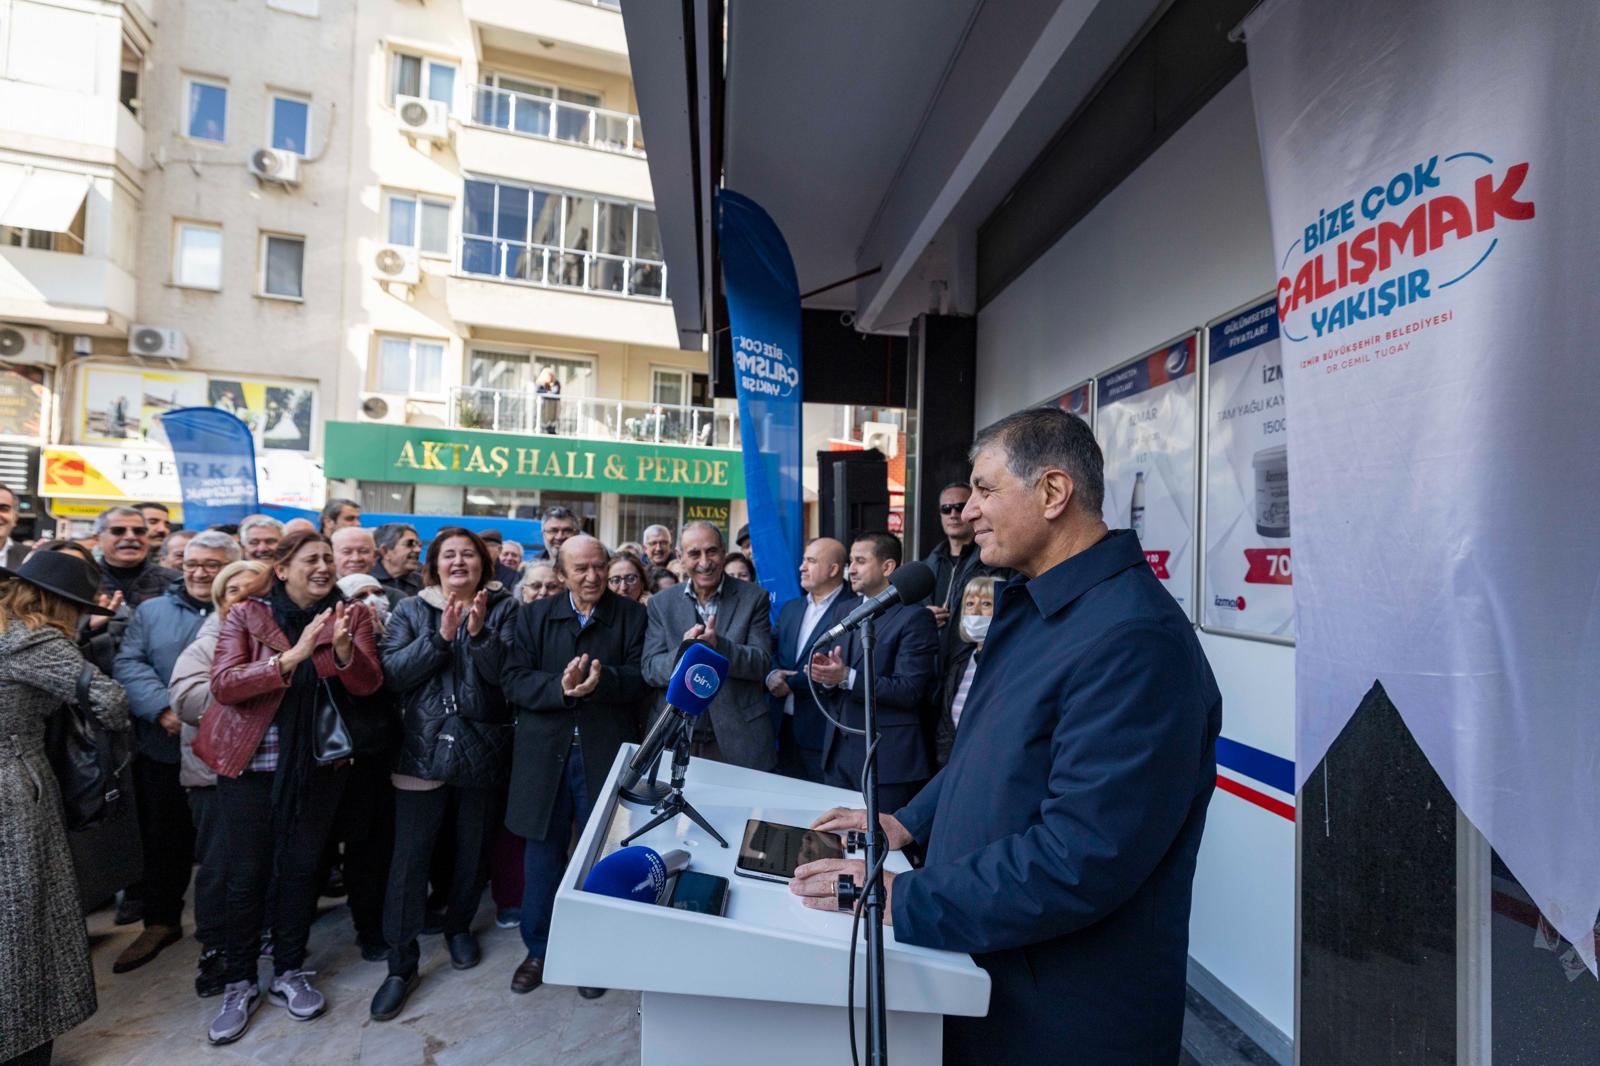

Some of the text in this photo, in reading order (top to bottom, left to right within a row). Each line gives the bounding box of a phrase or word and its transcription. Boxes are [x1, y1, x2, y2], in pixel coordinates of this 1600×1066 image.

[1303, 155, 1440, 254] BİZE ÇOK
[1277, 162, 1536, 324] ÇALIŞMAK
[1311, 268, 1431, 338] YAKIŞIR
[1322, 334, 1381, 361] BÜYÜKŞEHİR
[1385, 309, 1453, 341] BELEDİYESİ
[1375, 341, 1411, 360] TUGAY
[1266, 395, 1285, 410] KAY
[394, 439, 729, 486] AKTAŞ HALI & PERDE
